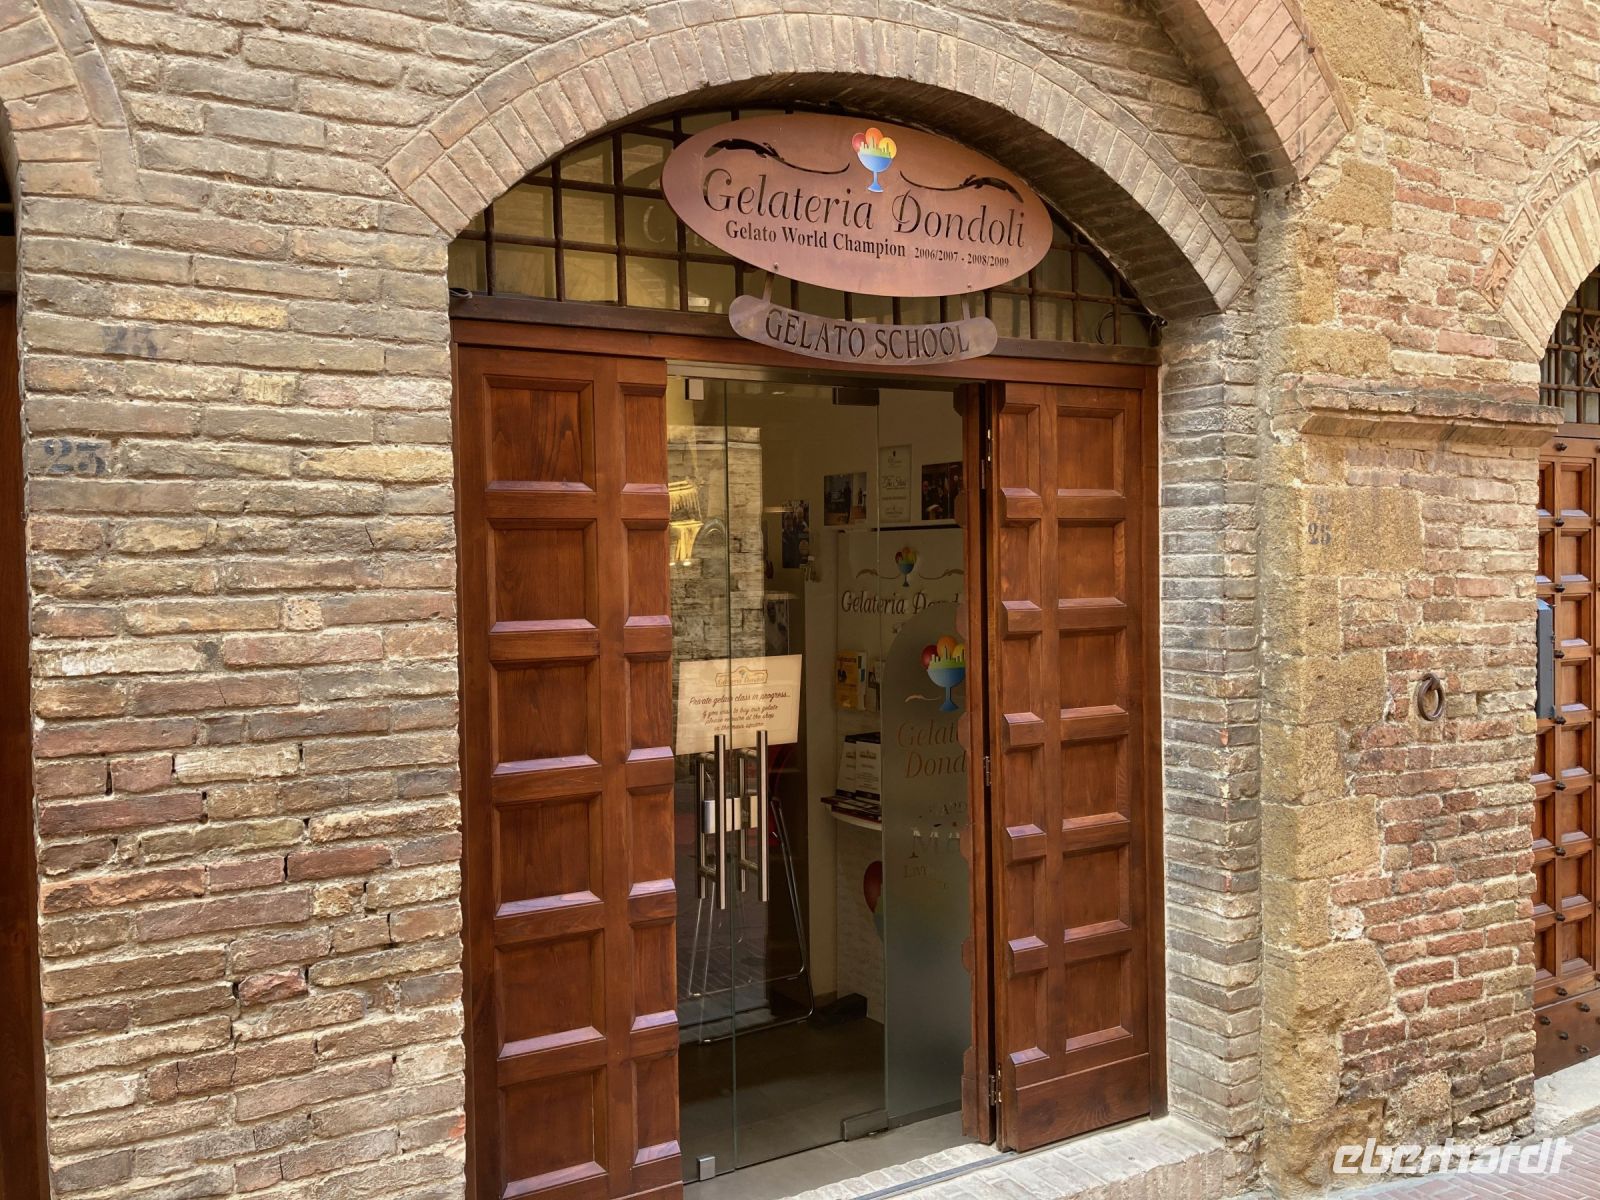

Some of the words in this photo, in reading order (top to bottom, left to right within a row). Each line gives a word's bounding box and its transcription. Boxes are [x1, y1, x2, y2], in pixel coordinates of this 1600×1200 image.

[703, 168, 873, 230] Gelateria
[892, 189, 1025, 248] Dondoli
[726, 220, 777, 243] Gelato
[782, 226, 828, 249] World
[833, 232, 907, 259] Champion
[914, 247, 959, 262] 2006/2007
[967, 253, 1010, 268] 2008/2009
[765, 308, 866, 358] GELATO
[875, 324, 970, 360] SCHOOL
[841, 590, 905, 616] Gelateria
